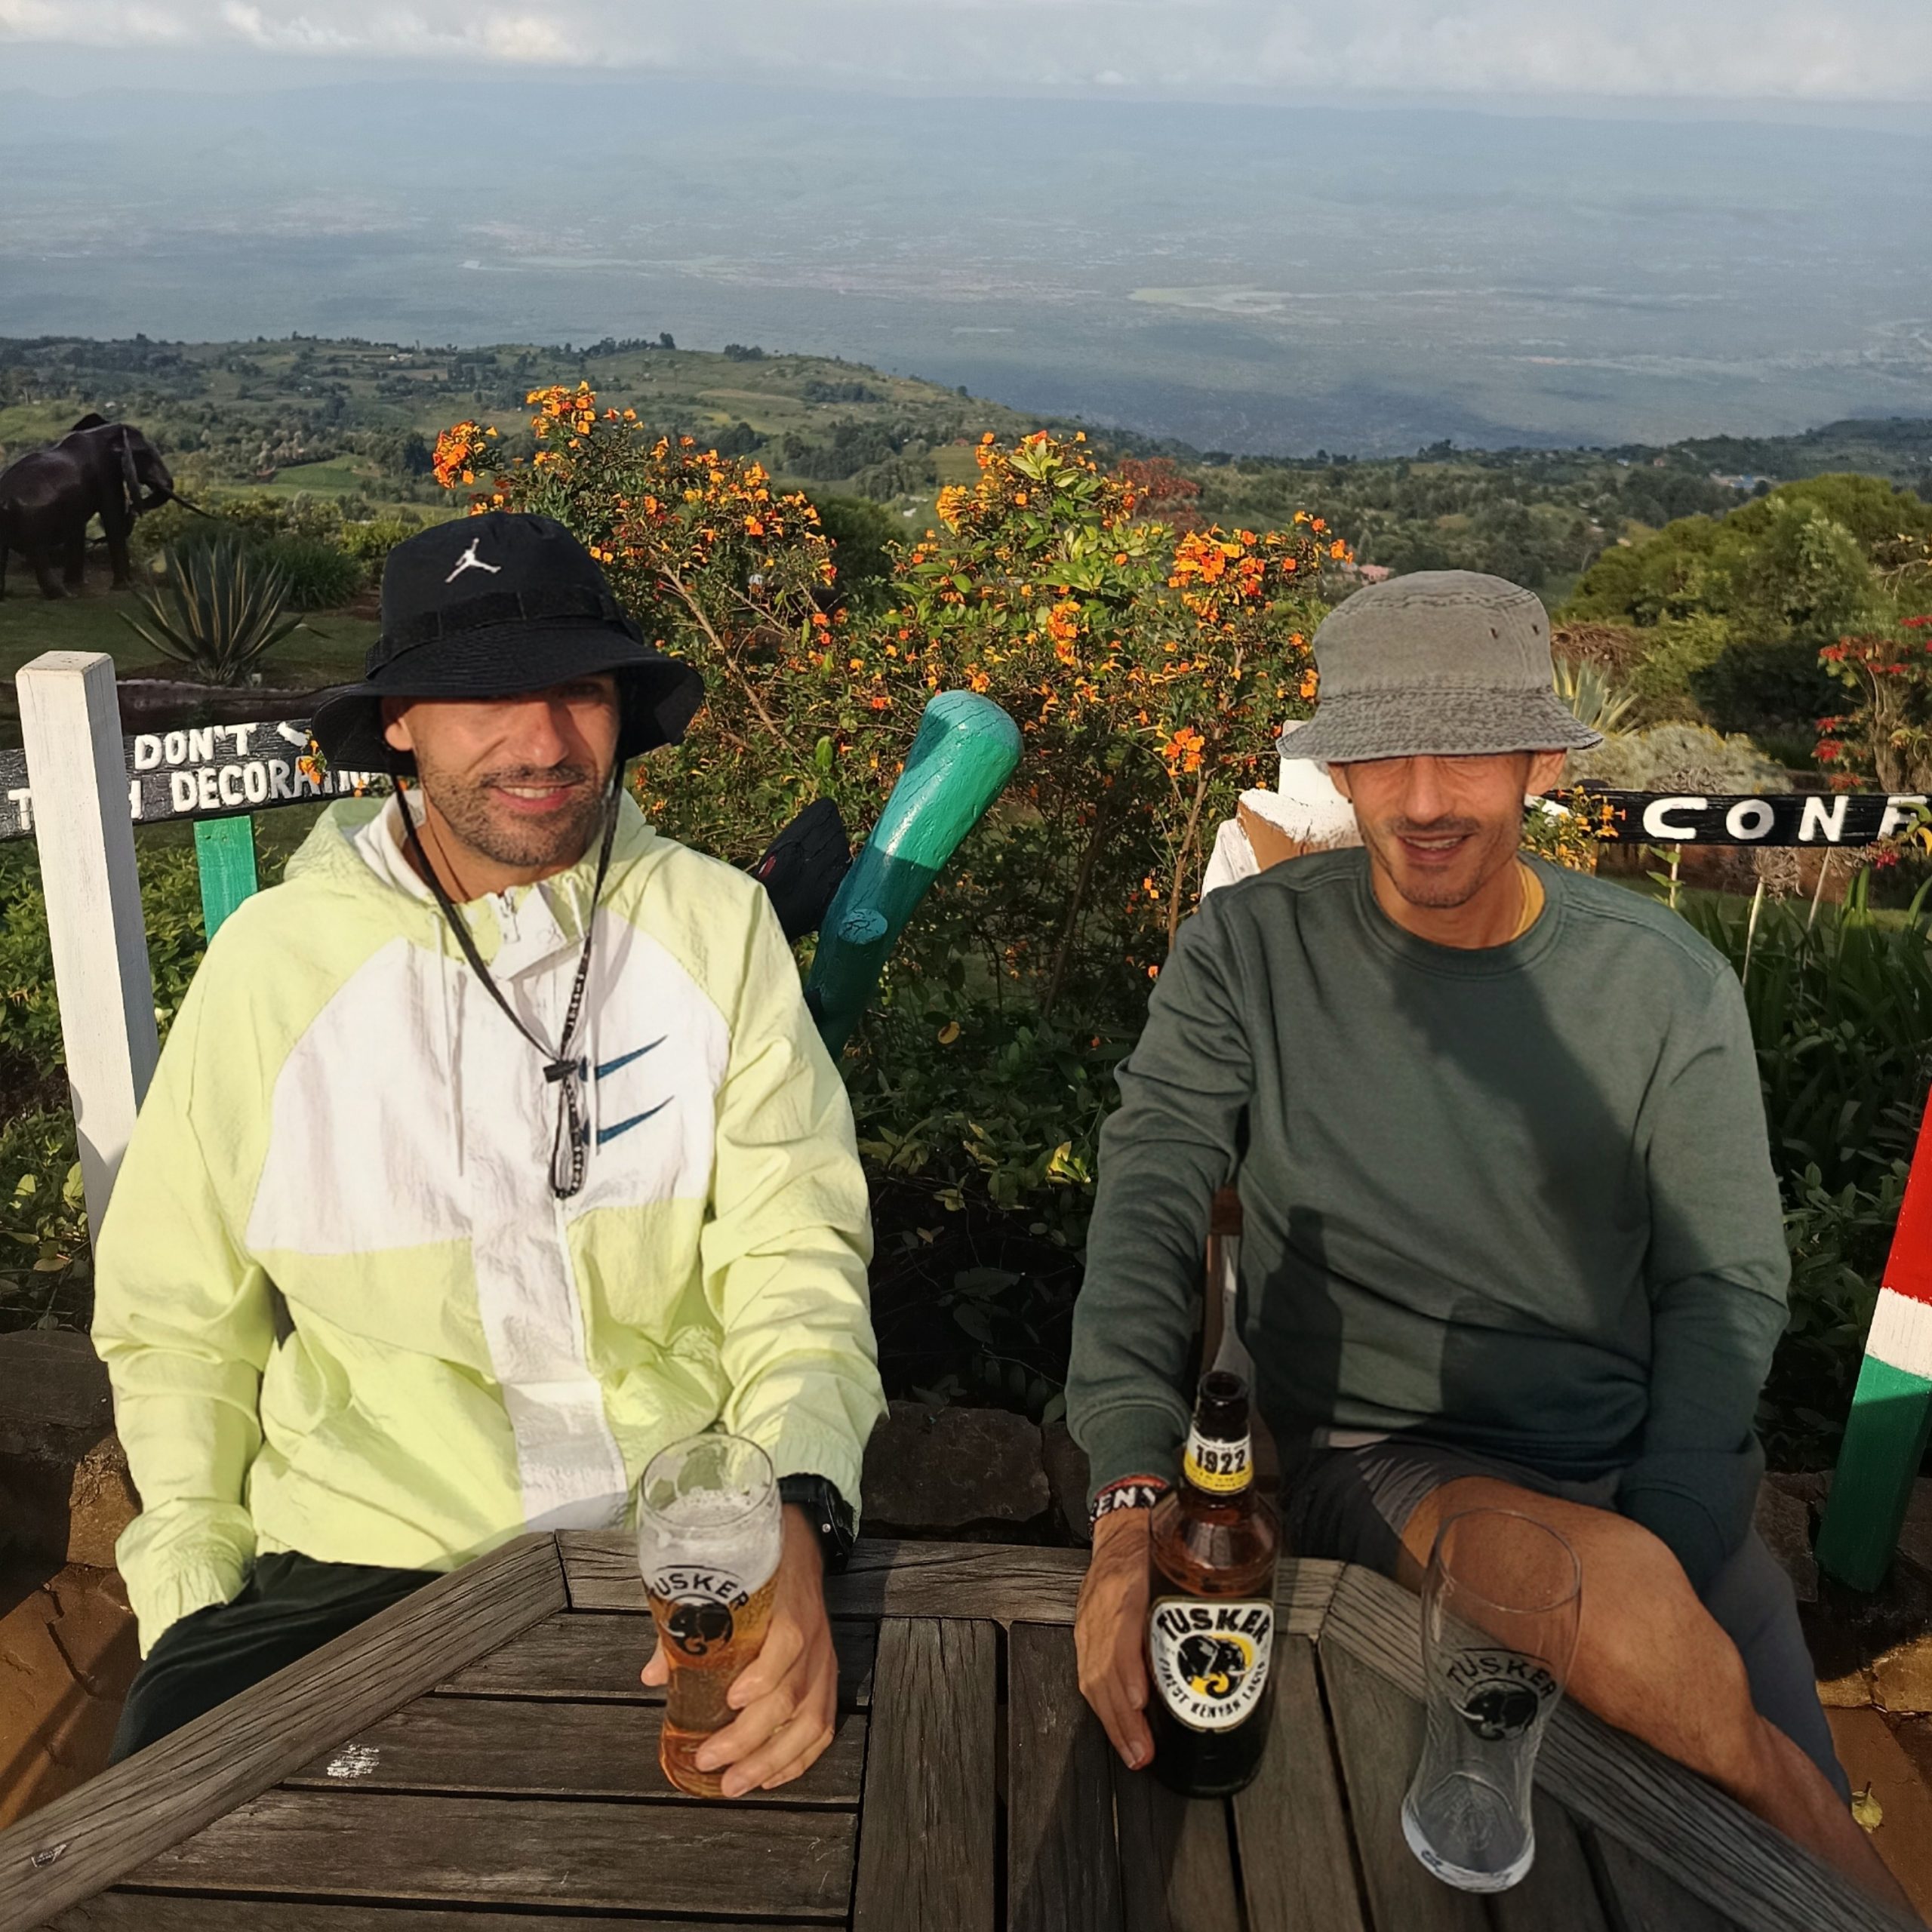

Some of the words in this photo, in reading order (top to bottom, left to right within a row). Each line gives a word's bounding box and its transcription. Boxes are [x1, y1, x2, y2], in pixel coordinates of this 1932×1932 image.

[134, 722, 258, 770] DON'T
[1196, 1444, 1245, 1475] 1922
[1157, 1608, 1270, 1645] TUSKER
[1447, 1653, 1557, 1700] TUSKER
